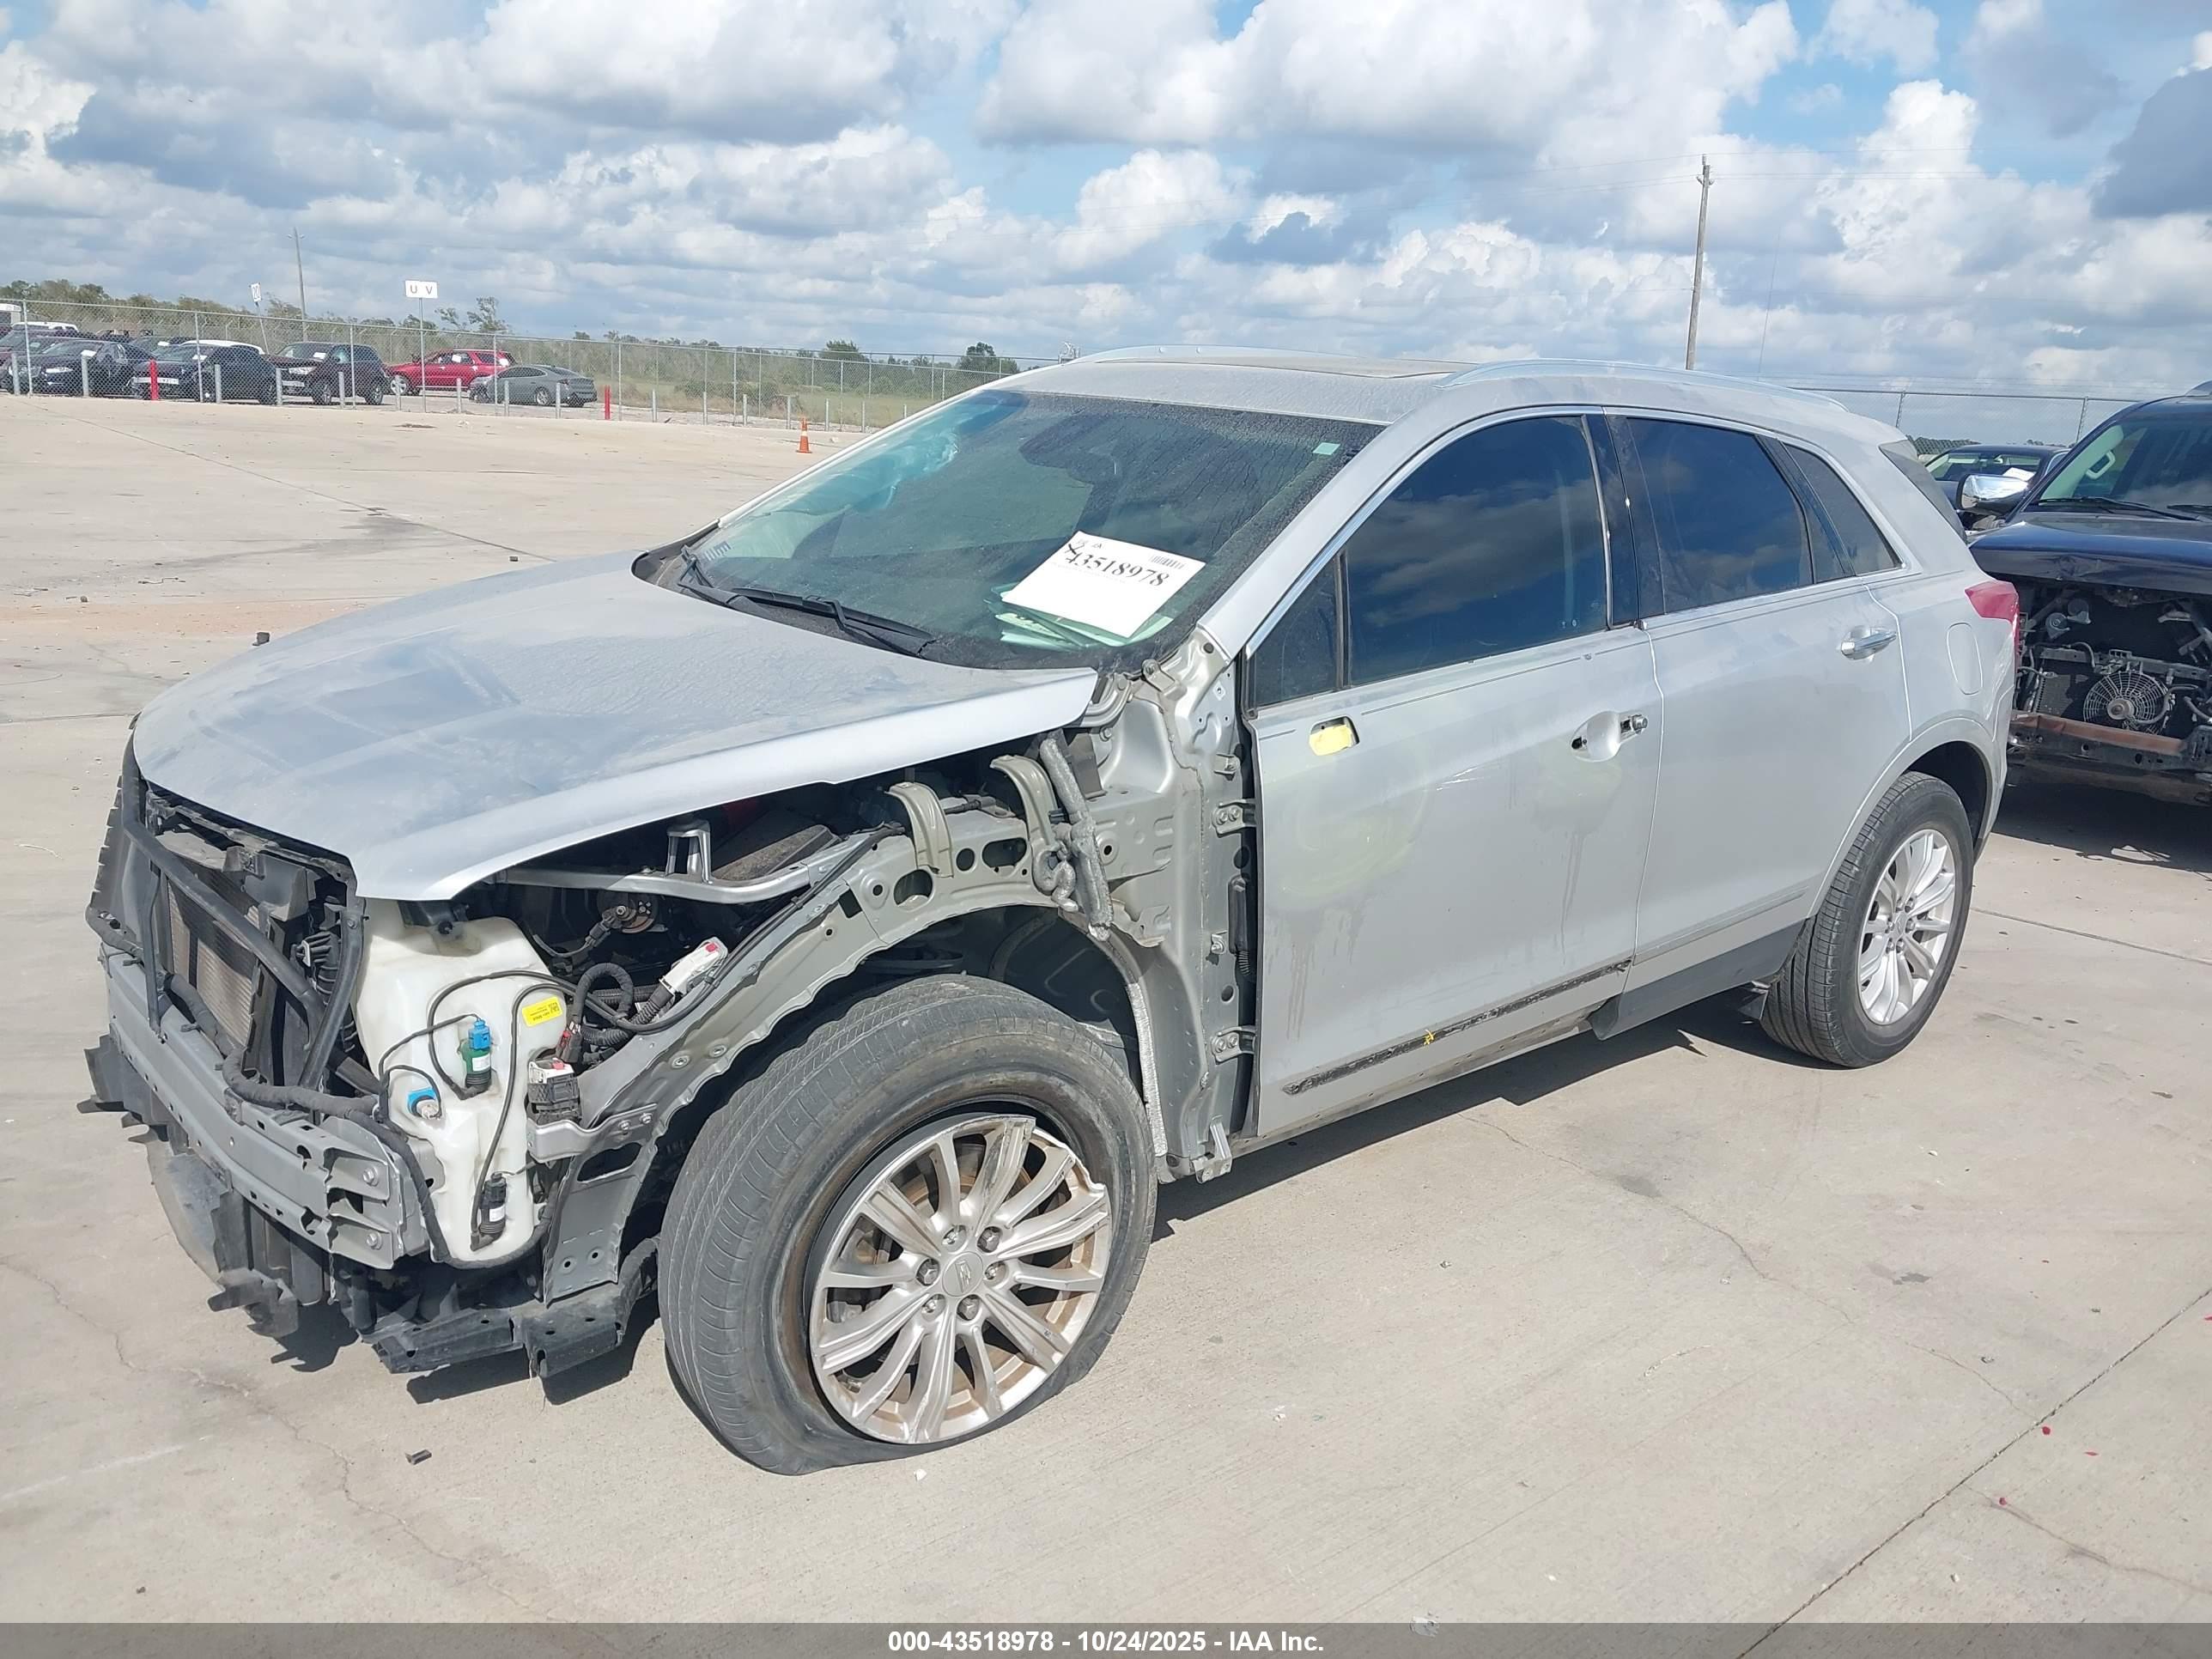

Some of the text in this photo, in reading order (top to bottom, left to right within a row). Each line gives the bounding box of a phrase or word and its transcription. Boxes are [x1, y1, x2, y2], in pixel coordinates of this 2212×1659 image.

[410, 284, 433, 295] U V
[1065, 552, 1170, 586] 43518978
